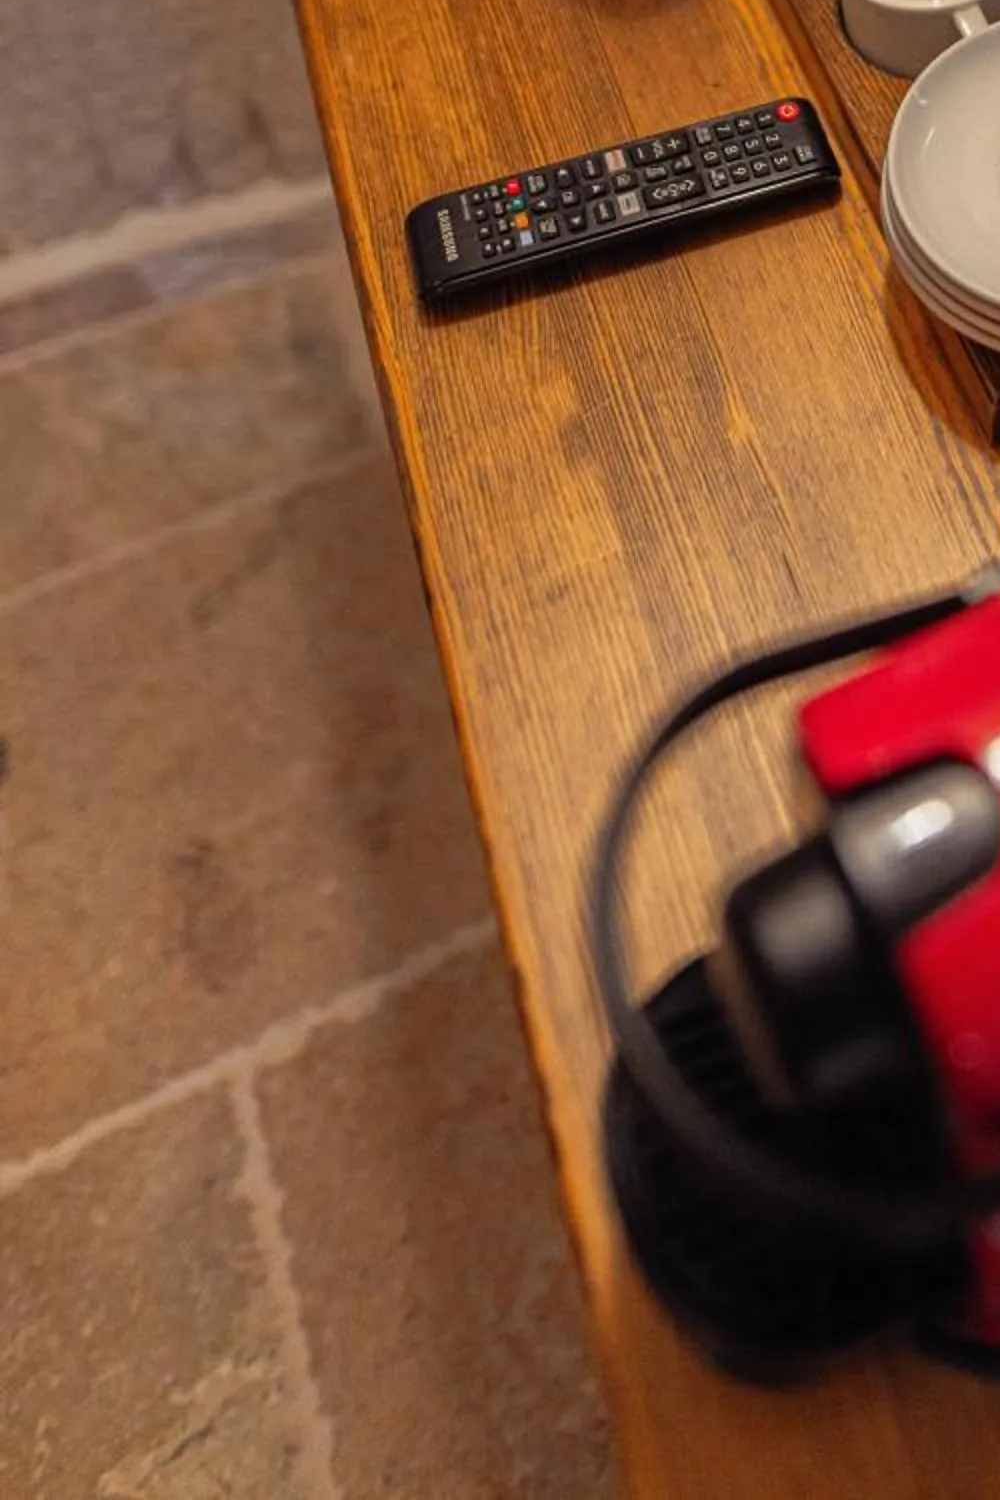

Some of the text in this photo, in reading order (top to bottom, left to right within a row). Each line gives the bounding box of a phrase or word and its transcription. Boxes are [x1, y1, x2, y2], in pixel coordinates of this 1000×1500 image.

[745, 139, 758, 148] 5
[724, 146, 738, 154] 8
[754, 162, 766, 170] 6
[437, 208, 459, 263] SAMSUNG
